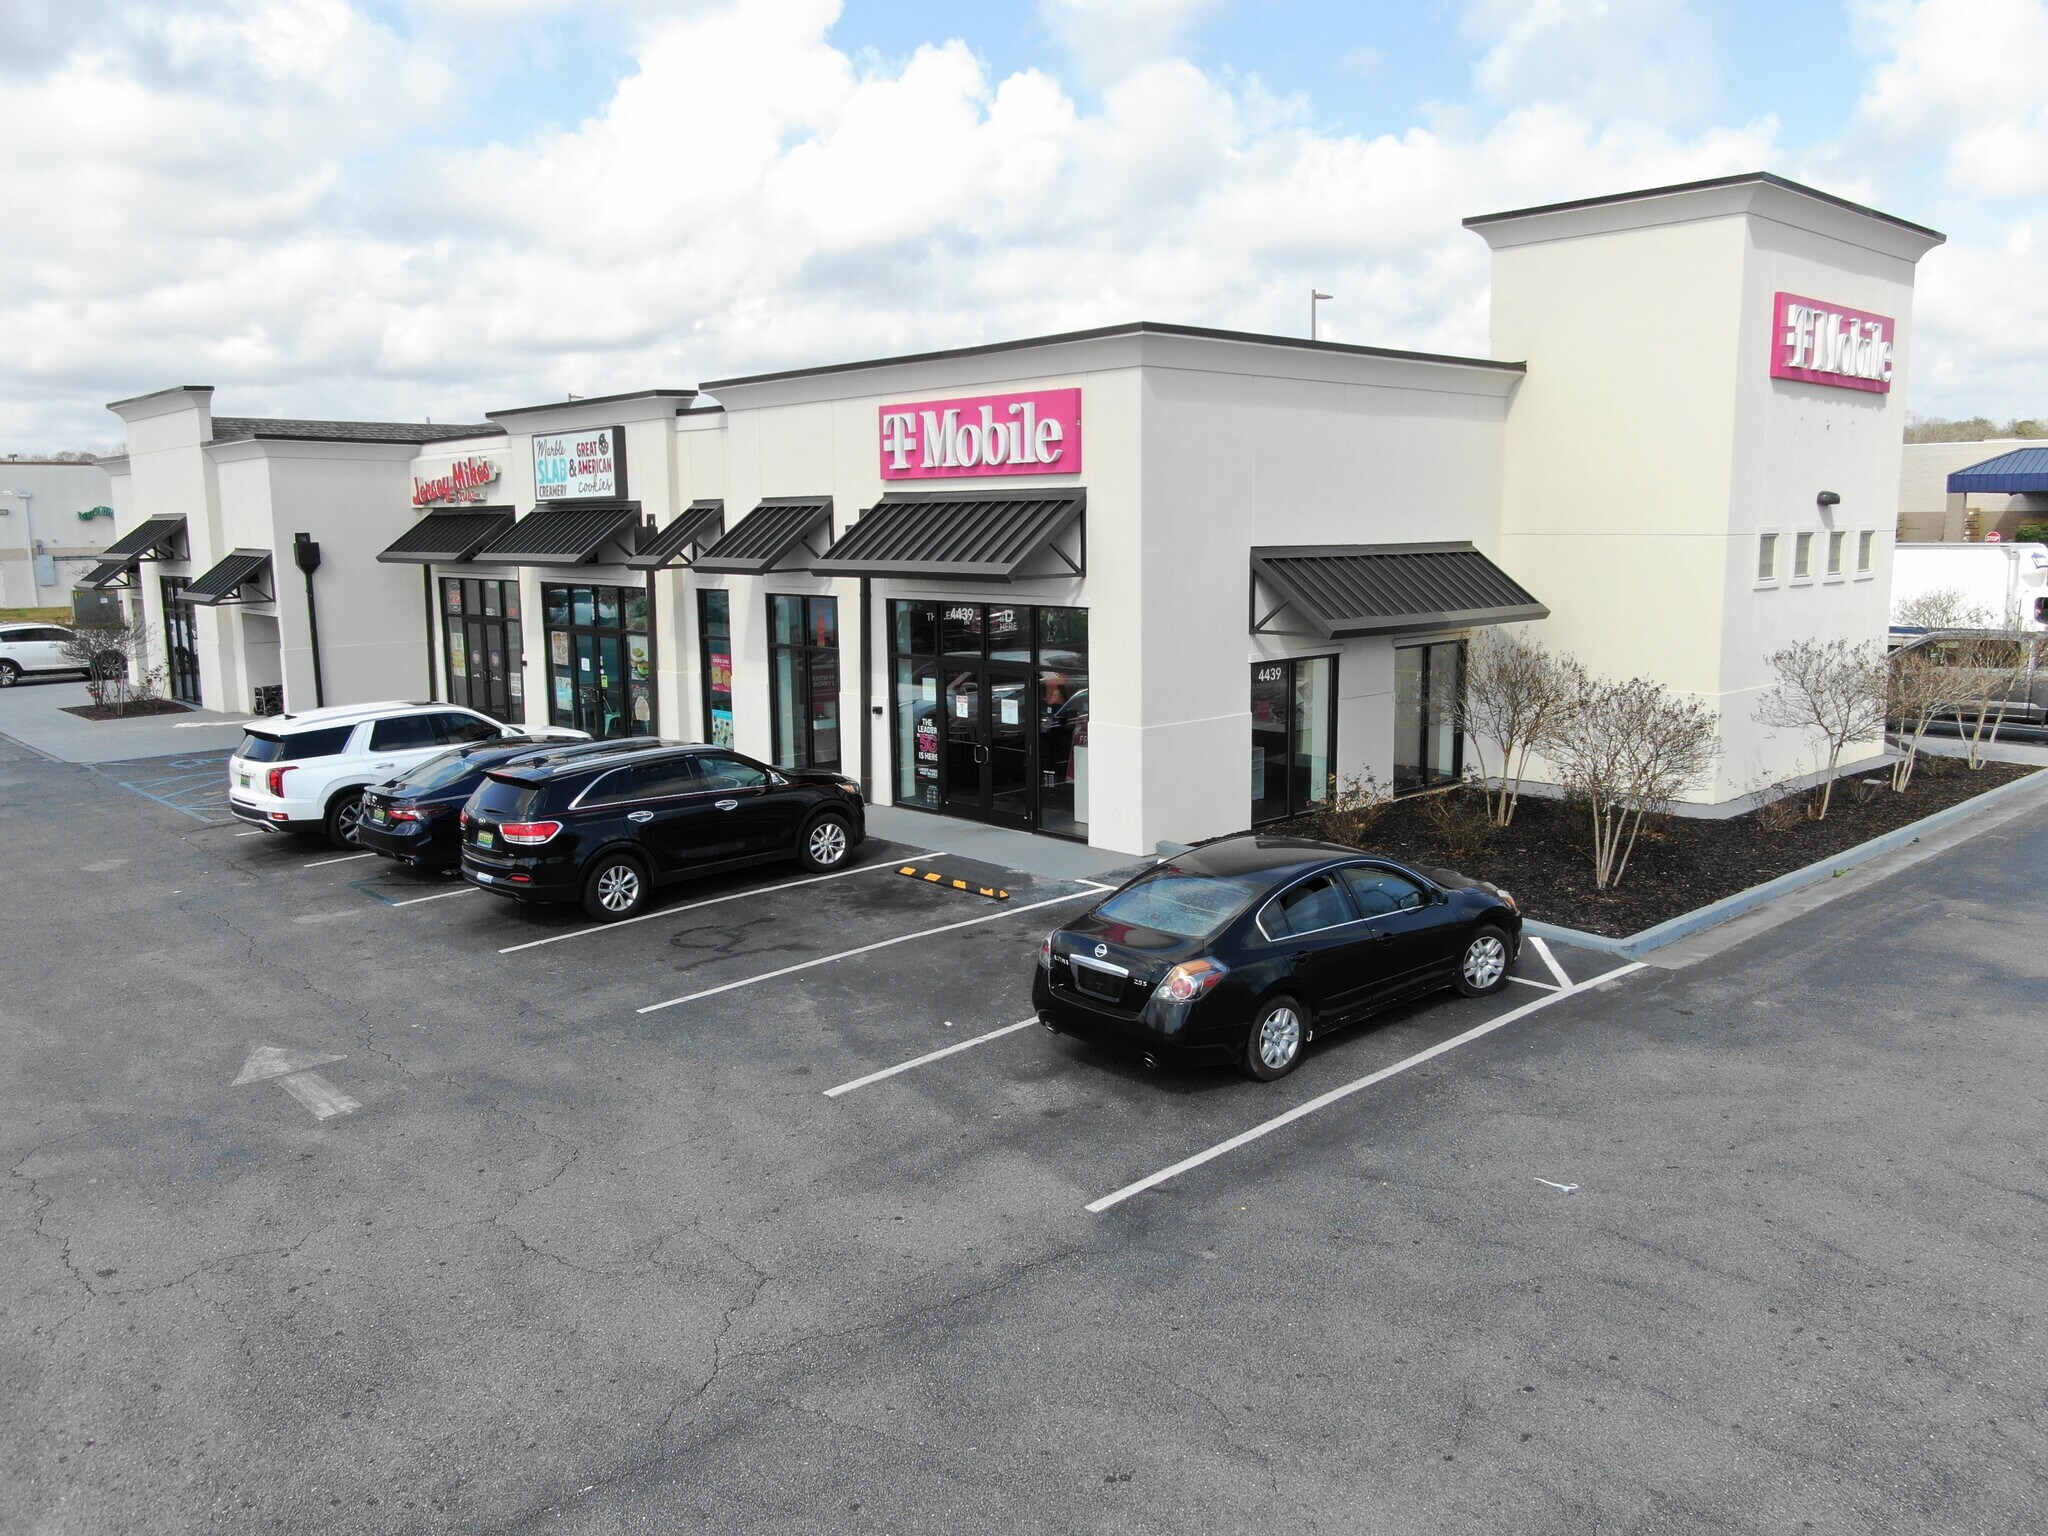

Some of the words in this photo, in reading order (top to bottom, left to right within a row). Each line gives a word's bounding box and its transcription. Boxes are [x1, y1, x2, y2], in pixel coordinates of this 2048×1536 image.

[537, 439, 566, 459] Marble
[576, 441, 597, 457] GREAT
[537, 458, 567, 484] SLAB
[569, 459, 577, 478] &
[578, 457, 612, 475] AMERICAN
[412, 476, 455, 505] Jersey
[539, 484, 567, 497] CREAMERY
[951, 607, 974, 621] 4439
[1000, 622, 1018, 631] HERE
[1258, 667, 1281, 682] 4439
[918, 725, 937, 734] LEADER
[922, 718, 932, 726] THE
[920, 733, 937, 753] 5G
[925, 753, 938, 761] HERE
